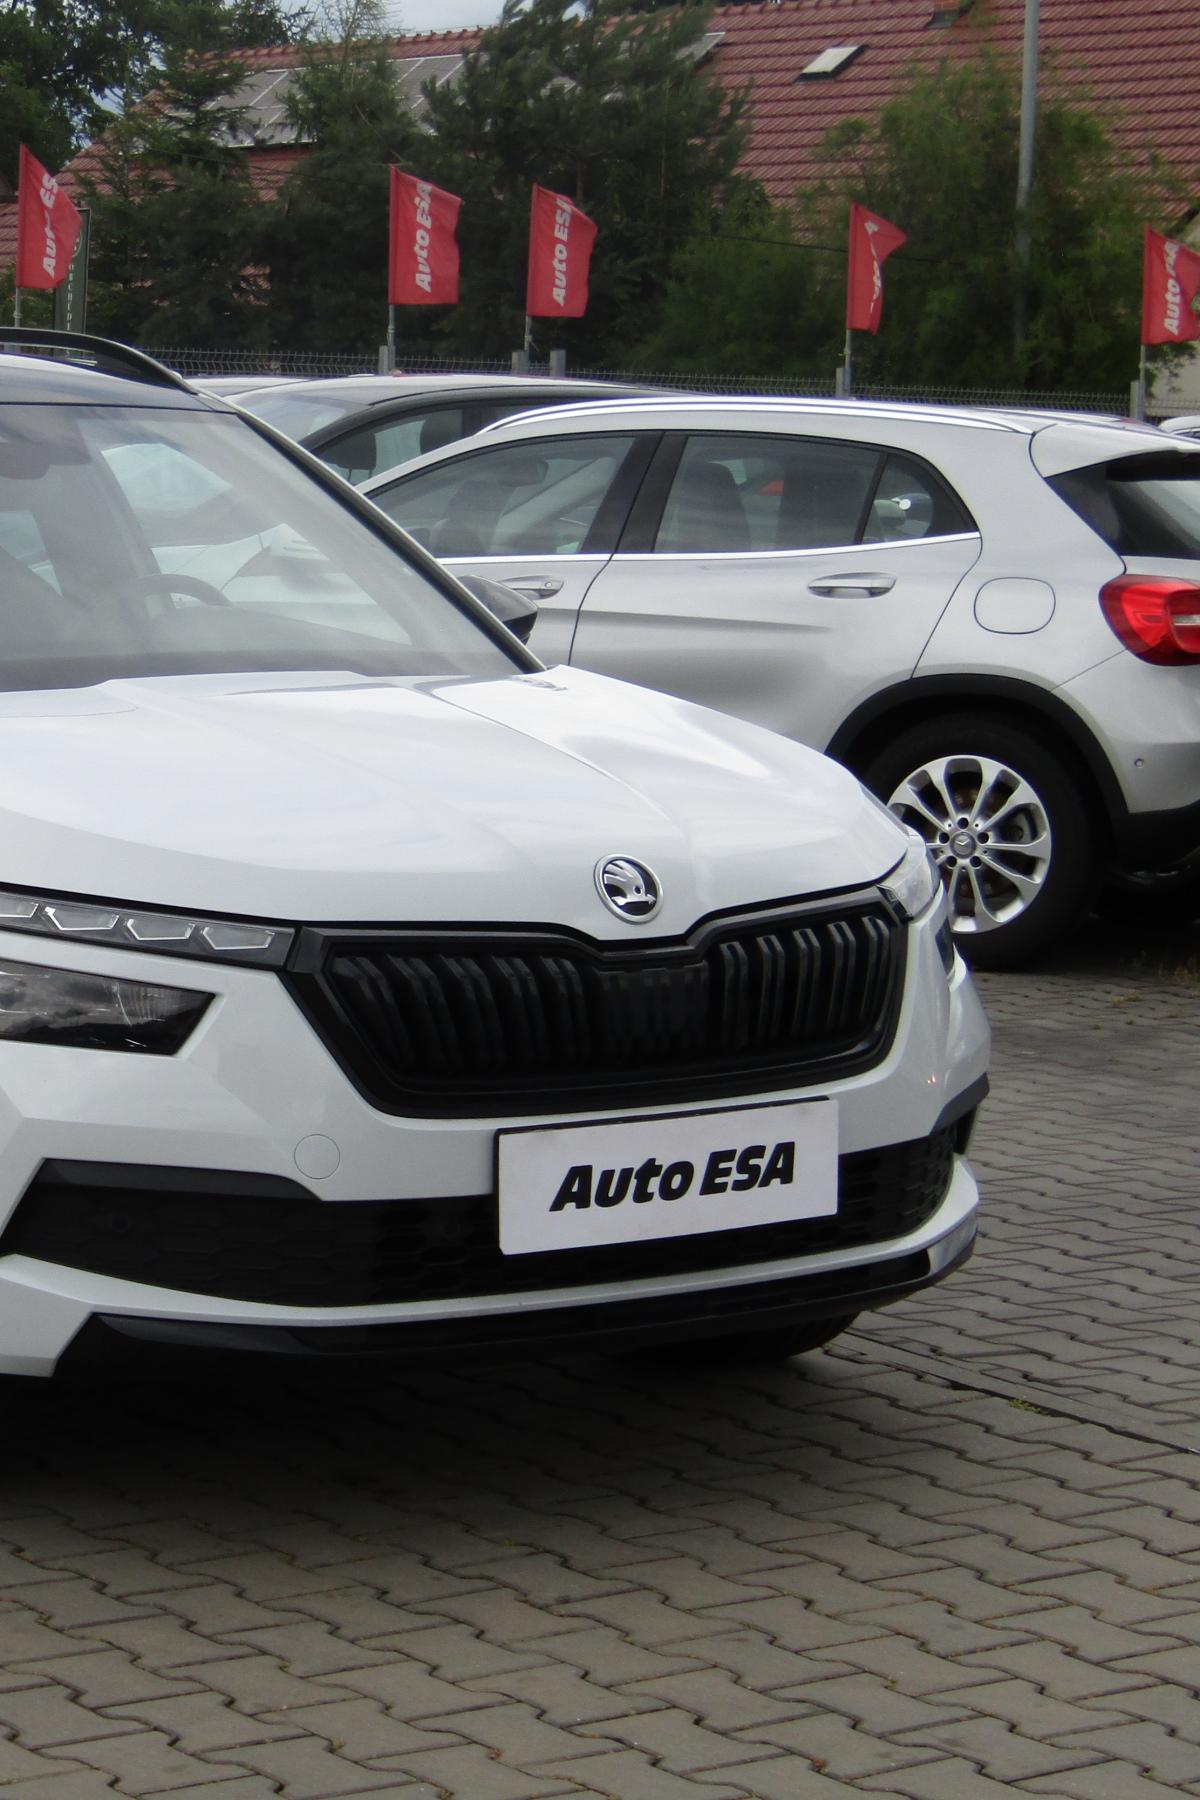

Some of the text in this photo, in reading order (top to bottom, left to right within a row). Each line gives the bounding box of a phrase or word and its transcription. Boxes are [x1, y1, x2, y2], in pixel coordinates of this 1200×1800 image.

[413, 229, 433, 293] Auto
[552, 243, 569, 307] Auto
[1164, 278, 1181, 336] Auto
[548, 1141, 796, 1213] Auto ESA
